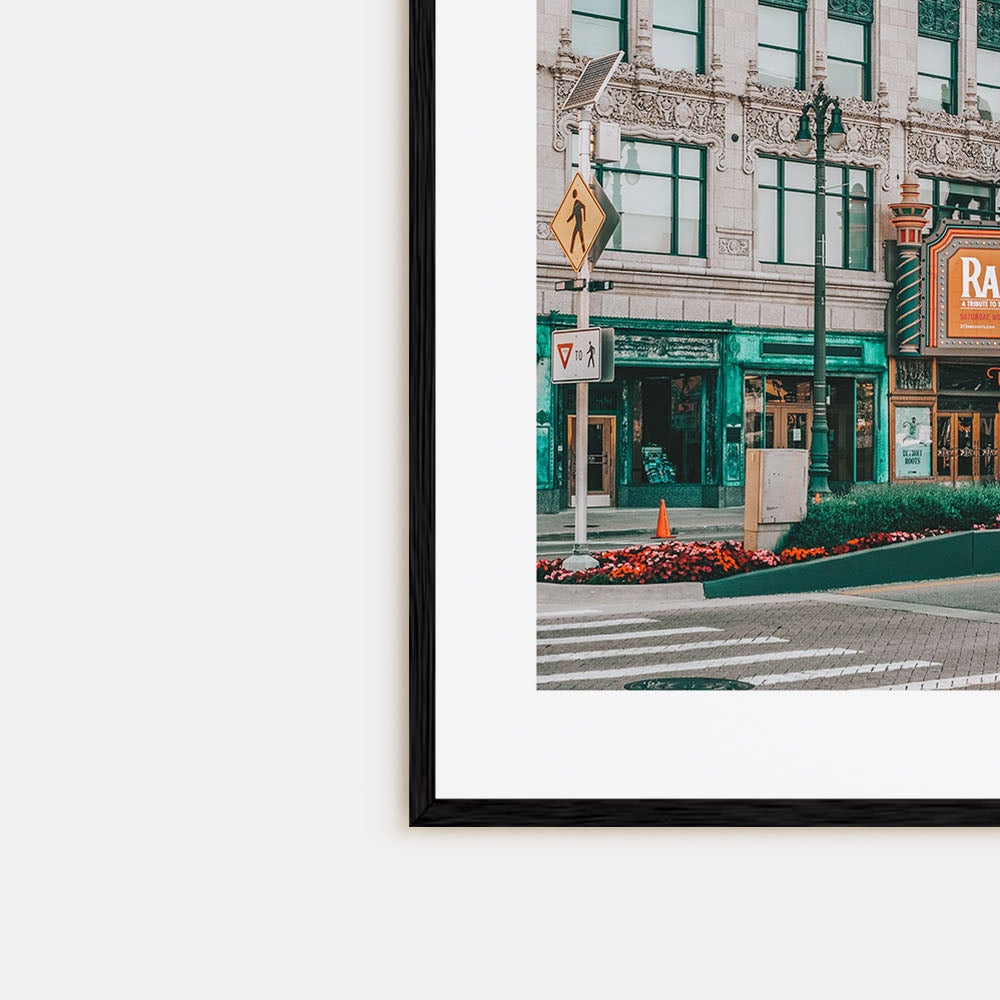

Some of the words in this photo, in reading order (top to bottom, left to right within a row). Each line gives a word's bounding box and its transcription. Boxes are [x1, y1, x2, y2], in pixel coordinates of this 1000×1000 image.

[967, 300, 988, 308] TRIBUTE
[989, 300, 997, 308] TO
[575, 350, 583, 361] TO
